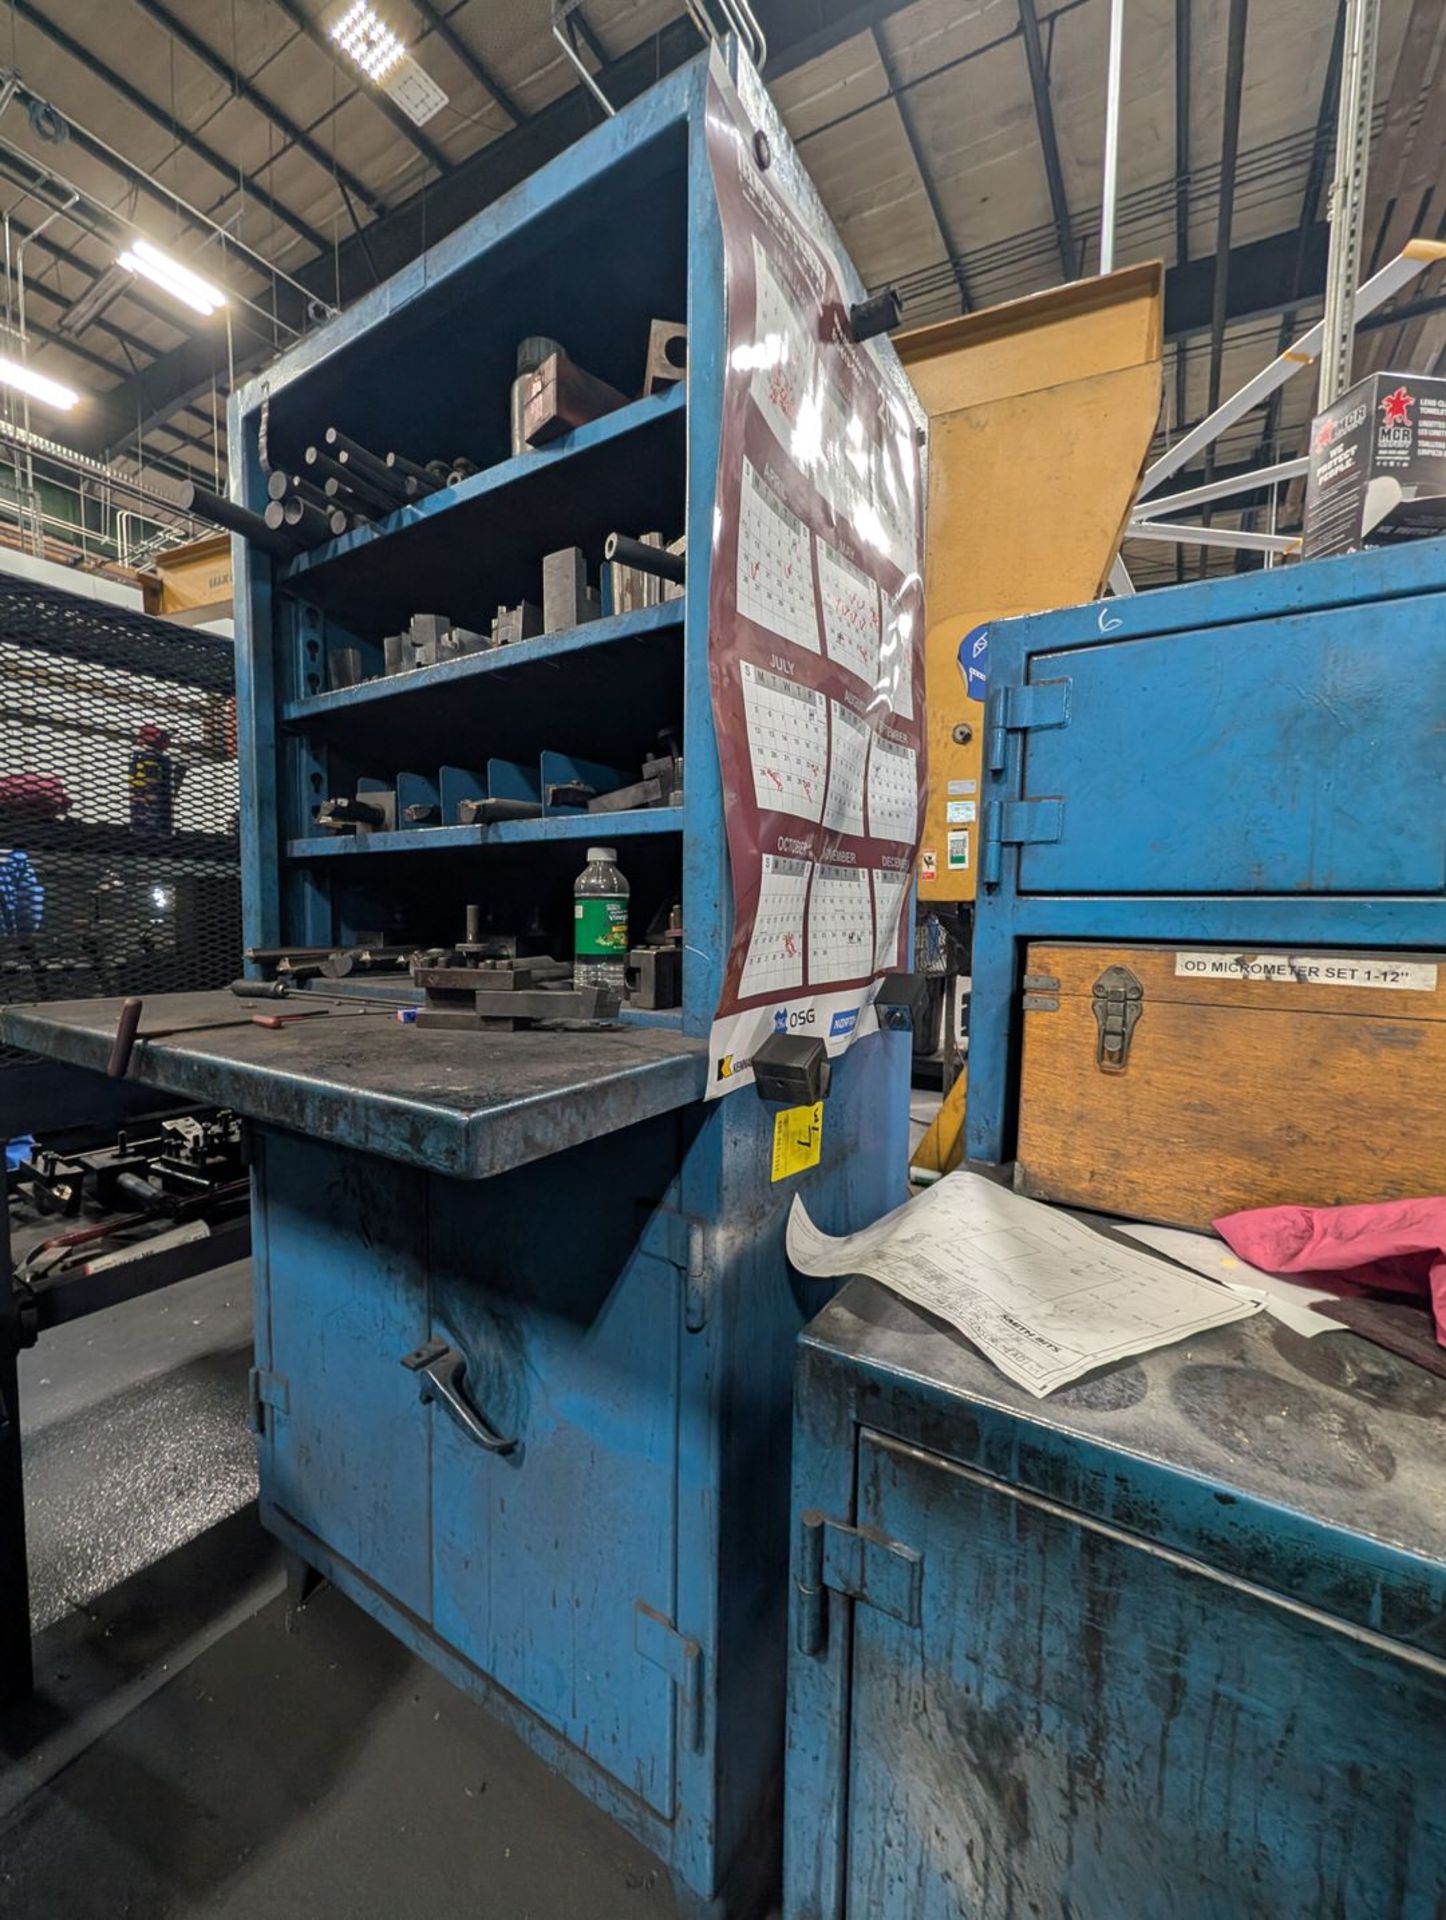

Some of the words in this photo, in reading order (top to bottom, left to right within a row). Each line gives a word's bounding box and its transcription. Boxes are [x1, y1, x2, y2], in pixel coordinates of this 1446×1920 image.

[1380, 428, 1411, 441] MCR
[1316, 444, 1358, 477] PROTECT
[1097, 608, 1123, 633] 6
[769, 653, 795, 676] JULY
[1184, 960, 1207, 972] OD
[1211, 961, 1320, 978] MICROMETER
[1325, 968, 1359, 980] SET
[1364, 970, 1410, 983] 1-12"
[789, 1008, 815, 1028] OSG
[1002, 1313, 1036, 1337] SMITH
[1035, 1337, 1062, 1354] BITS
